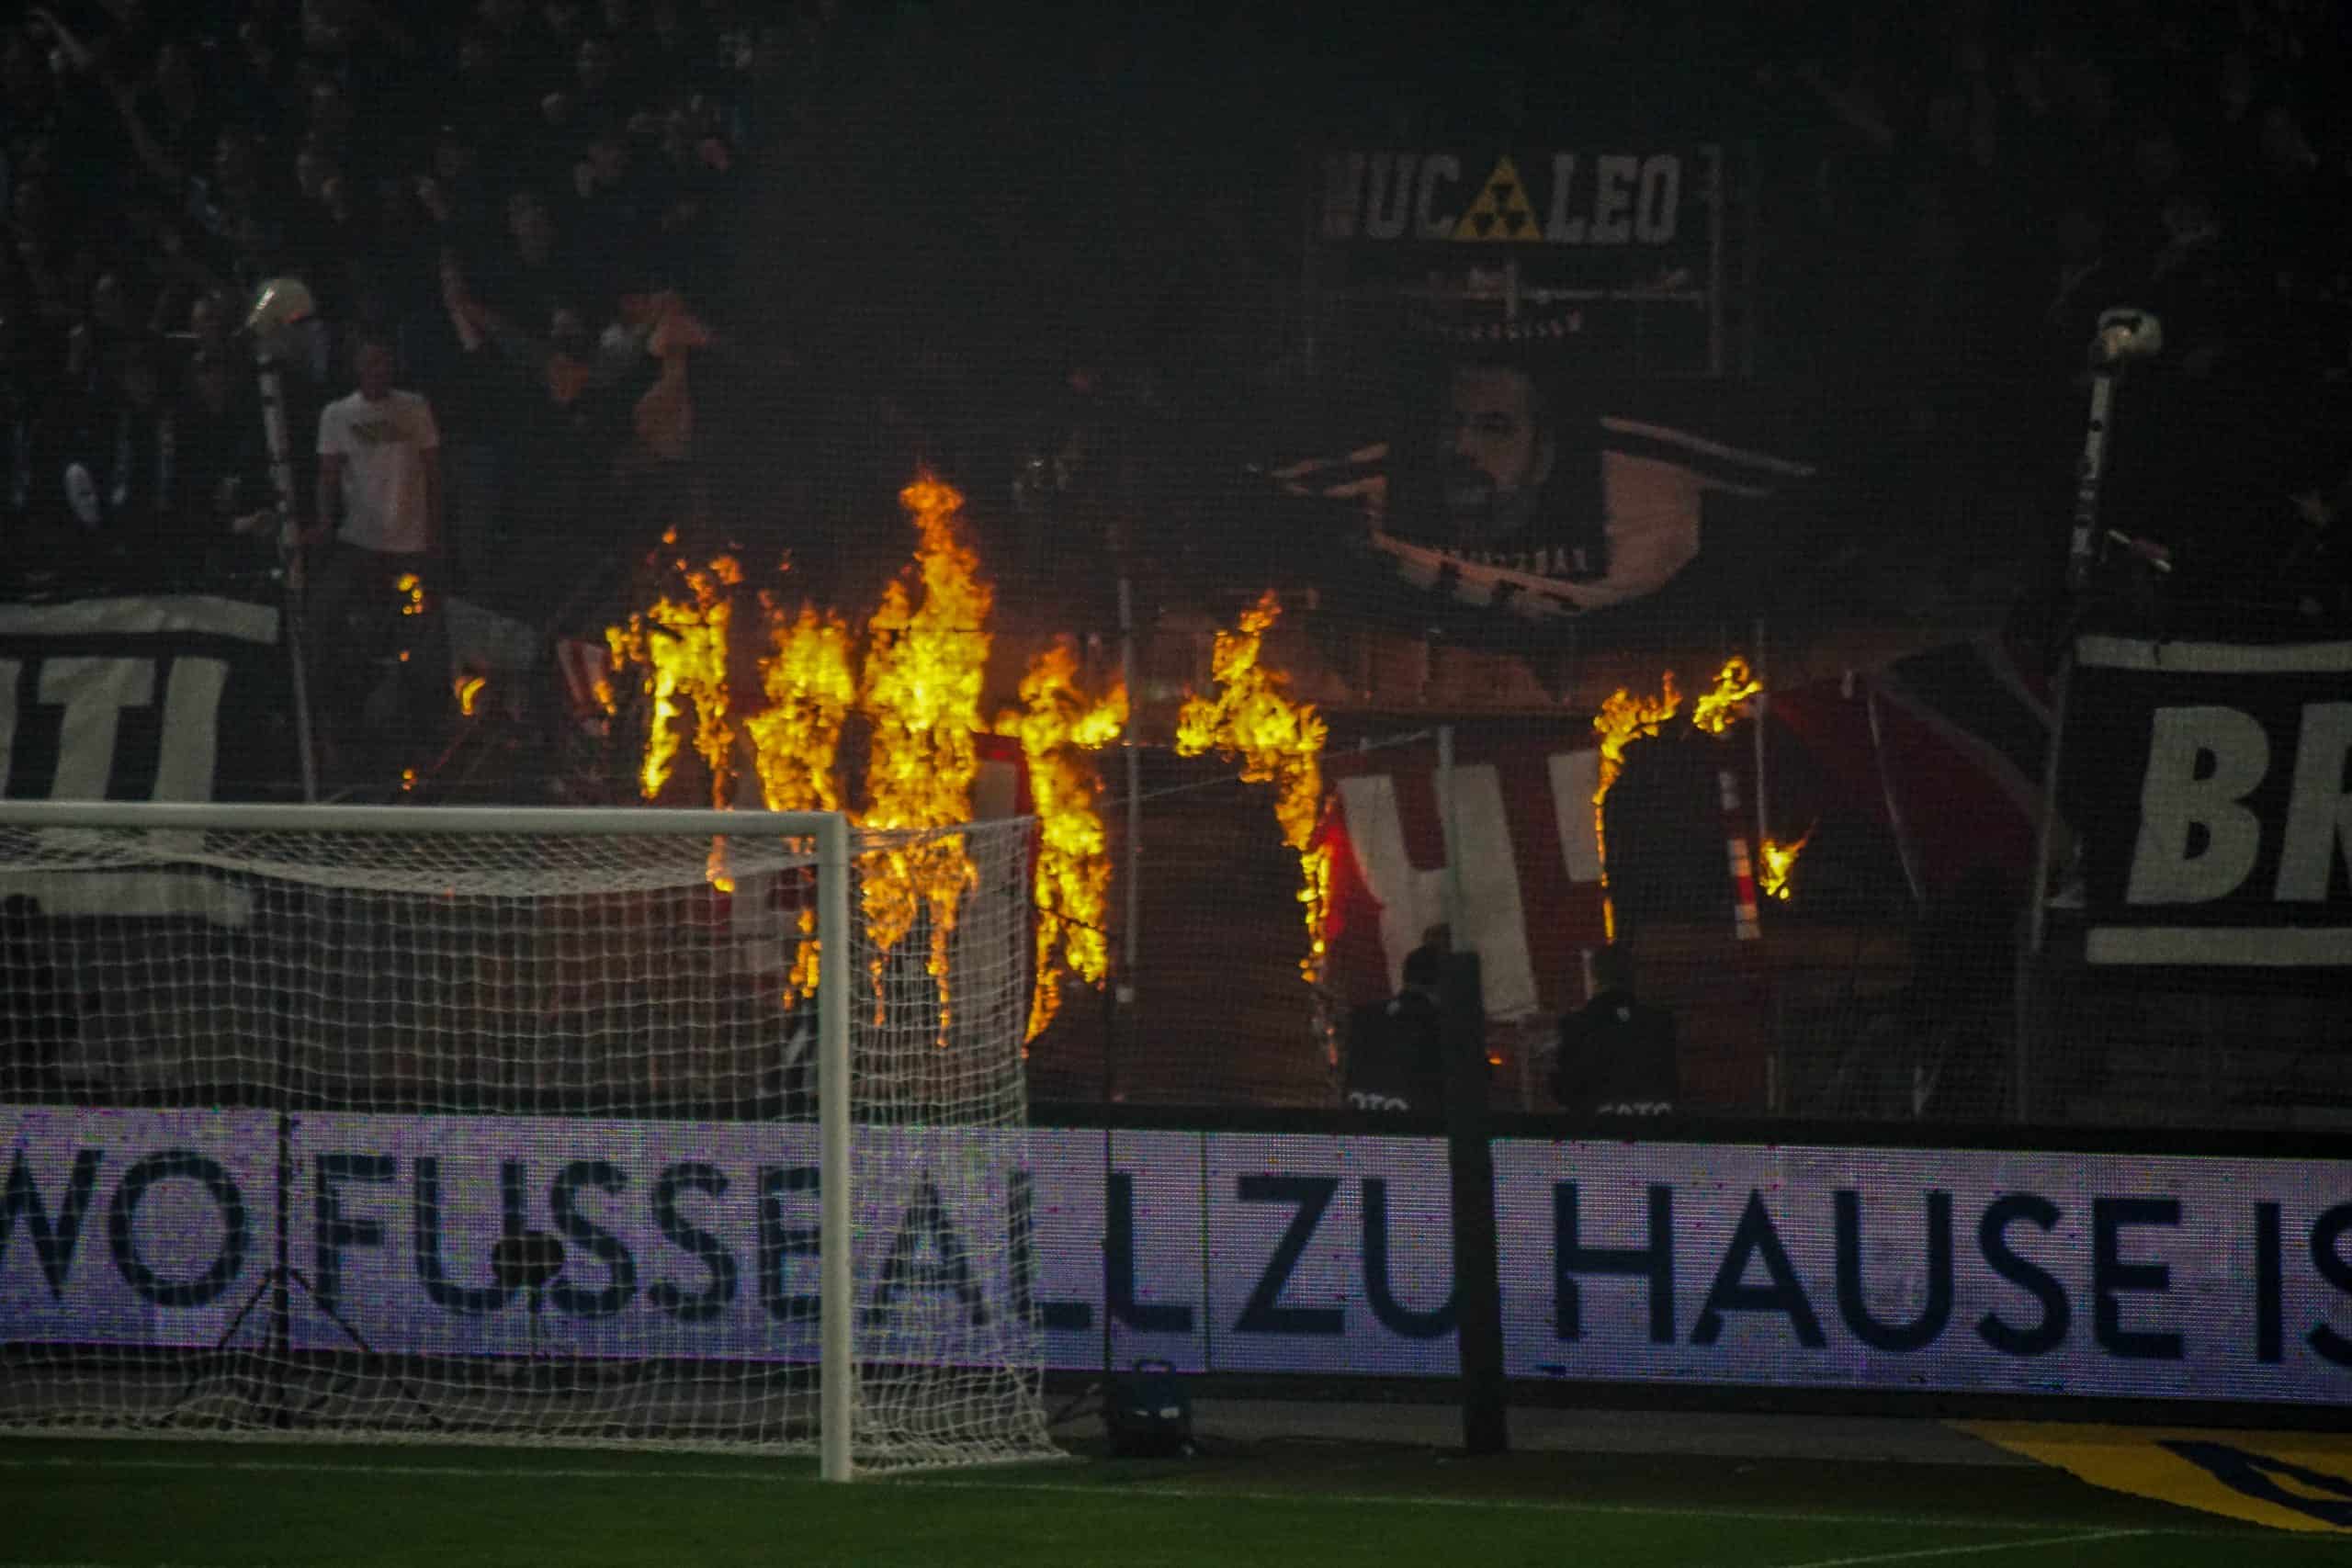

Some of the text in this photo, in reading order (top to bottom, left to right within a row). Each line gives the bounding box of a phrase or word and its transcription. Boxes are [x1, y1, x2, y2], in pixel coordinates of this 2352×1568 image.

[0, 1149, 248, 1307] WO
[1233, 1176, 1463, 1338] ZU
[1553, 1180, 2185, 1359] HAUSE
